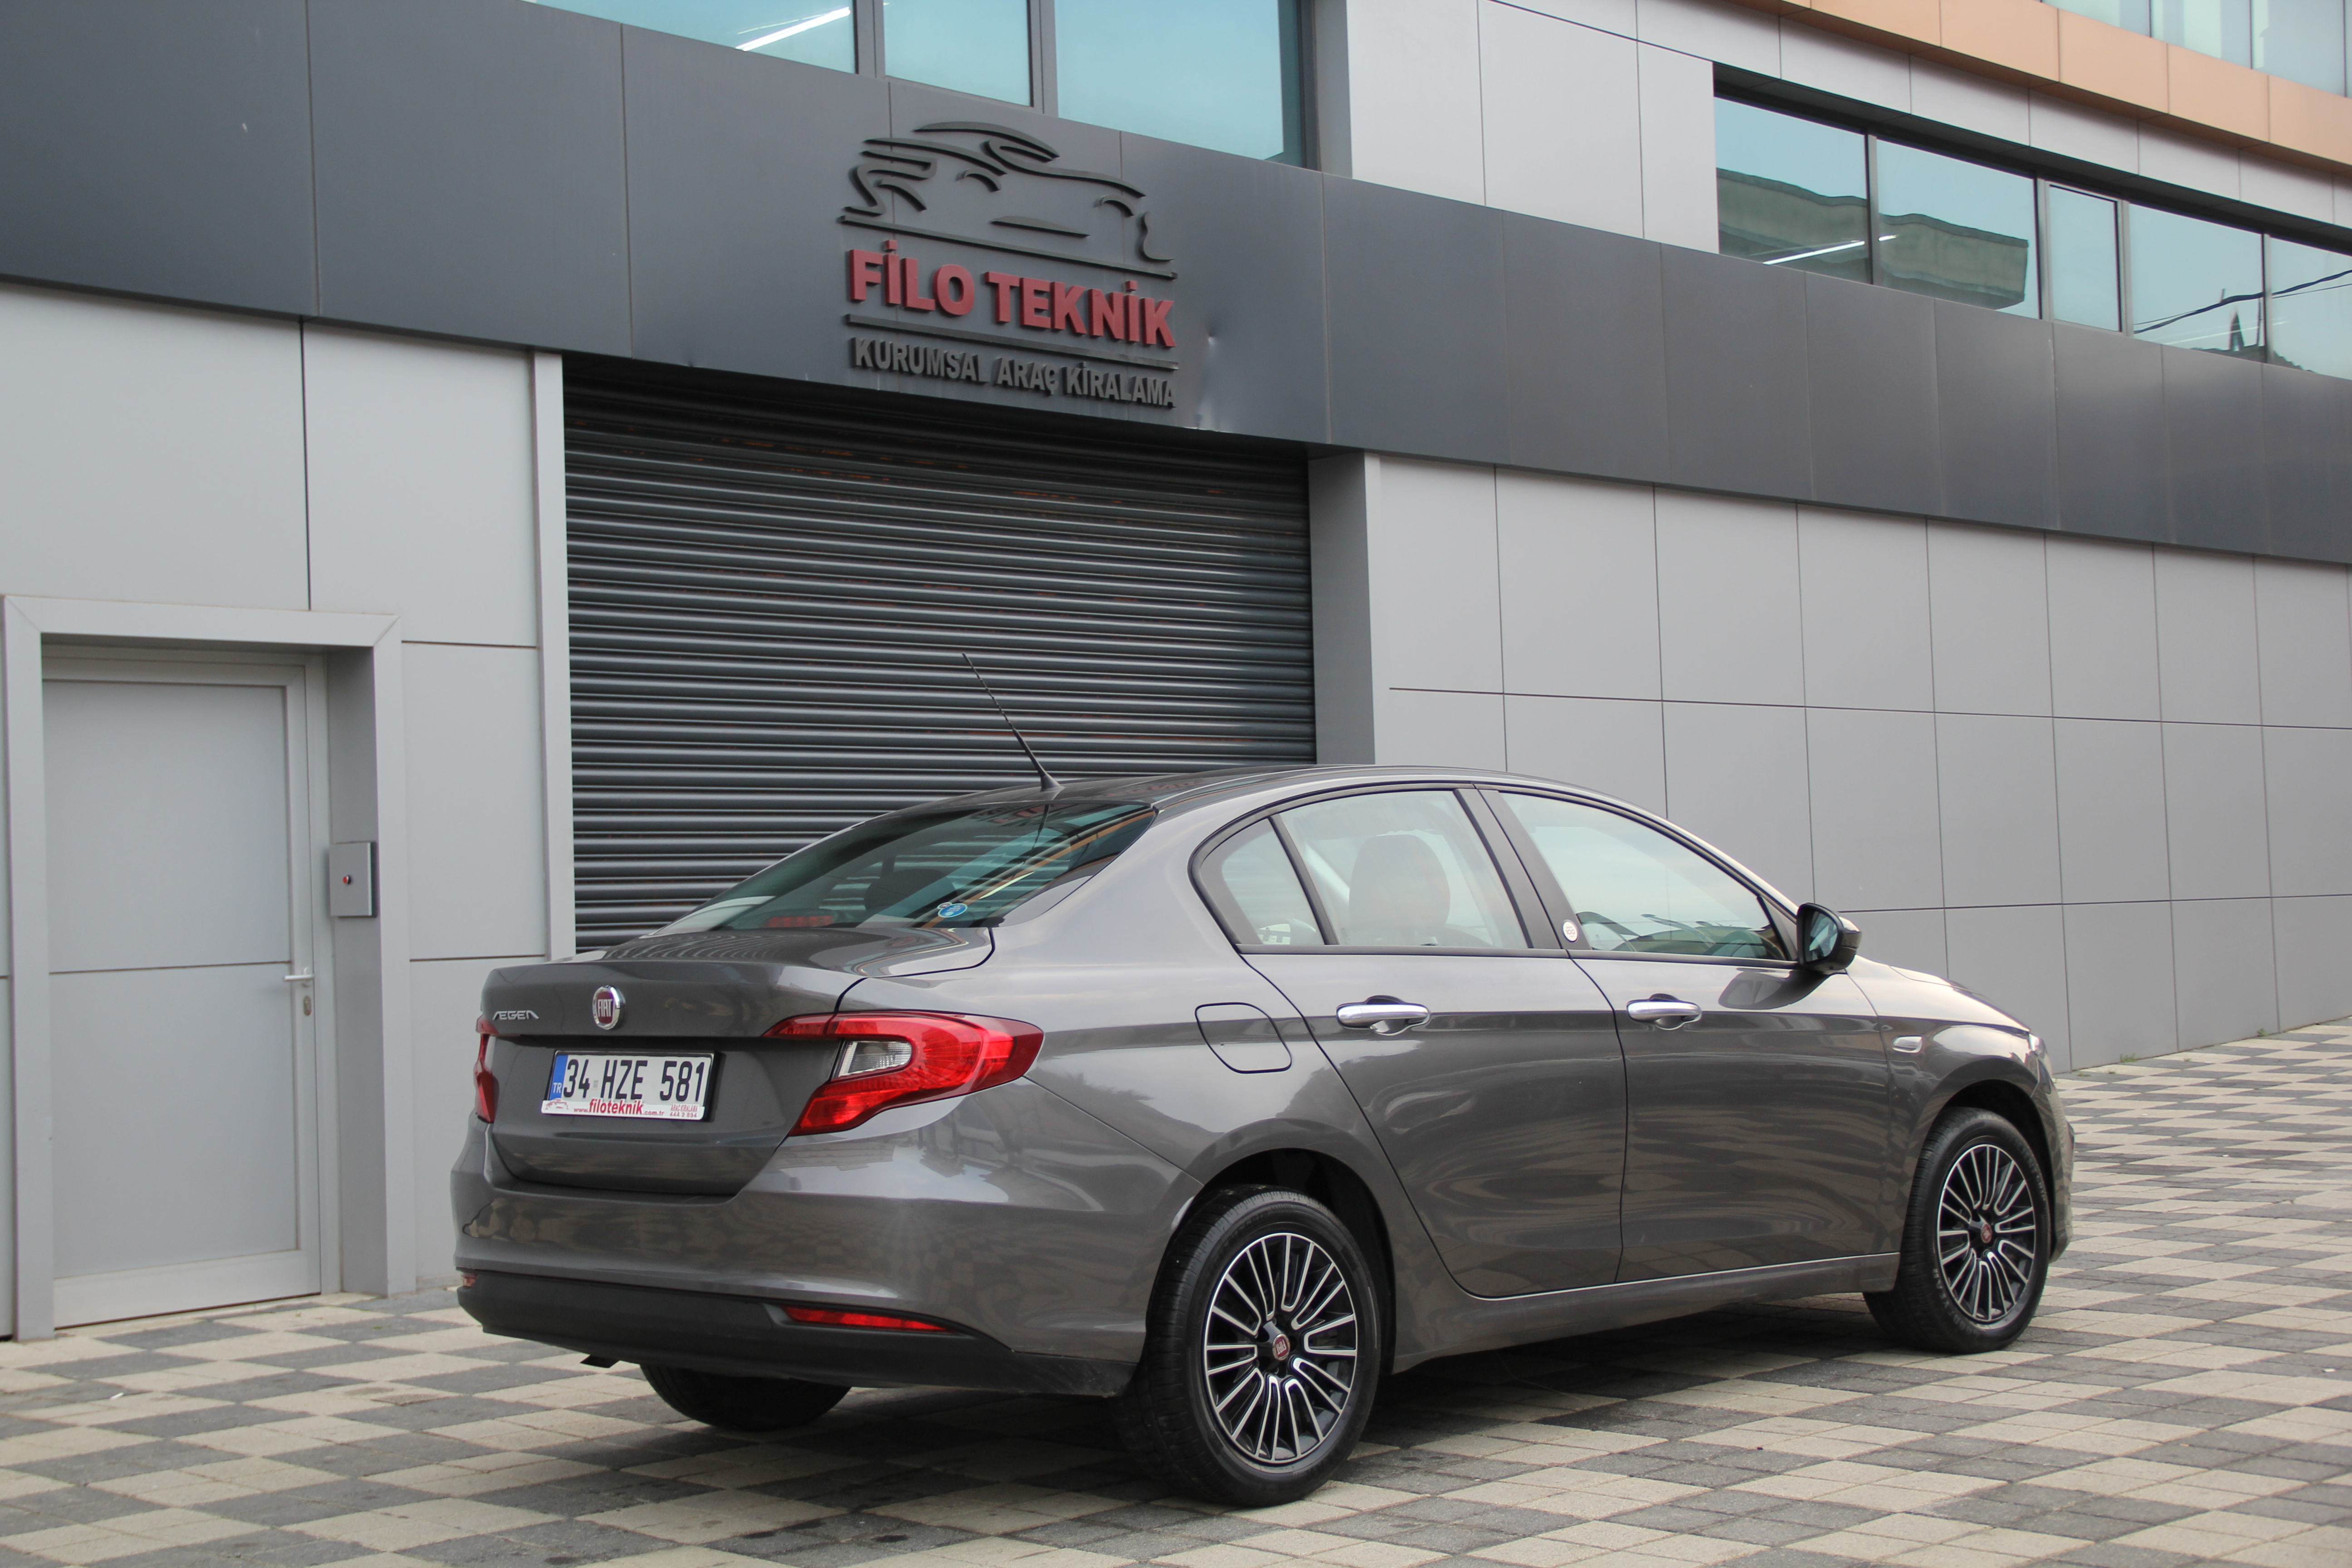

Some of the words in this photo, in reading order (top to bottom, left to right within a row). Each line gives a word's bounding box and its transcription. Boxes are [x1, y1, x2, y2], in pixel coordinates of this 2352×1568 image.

[848, 240, 975, 316] FİLO
[985, 272, 1176, 348] TEKNİK
[851, 337, 990, 385] KURUMSAL
[995, 356, 1059, 396] ARAÇ
[1065, 362, 1176, 408] KİRALAMA
[597, 998, 613, 1017] FIAT
[553, 1082, 562, 1093] TR
[564, 1059, 591, 1098] 34
[600, 1060, 648, 1101] HZE
[660, 1061, 705, 1102] 581
[573, 1098, 665, 1117] www.filoteknik.com.tr
